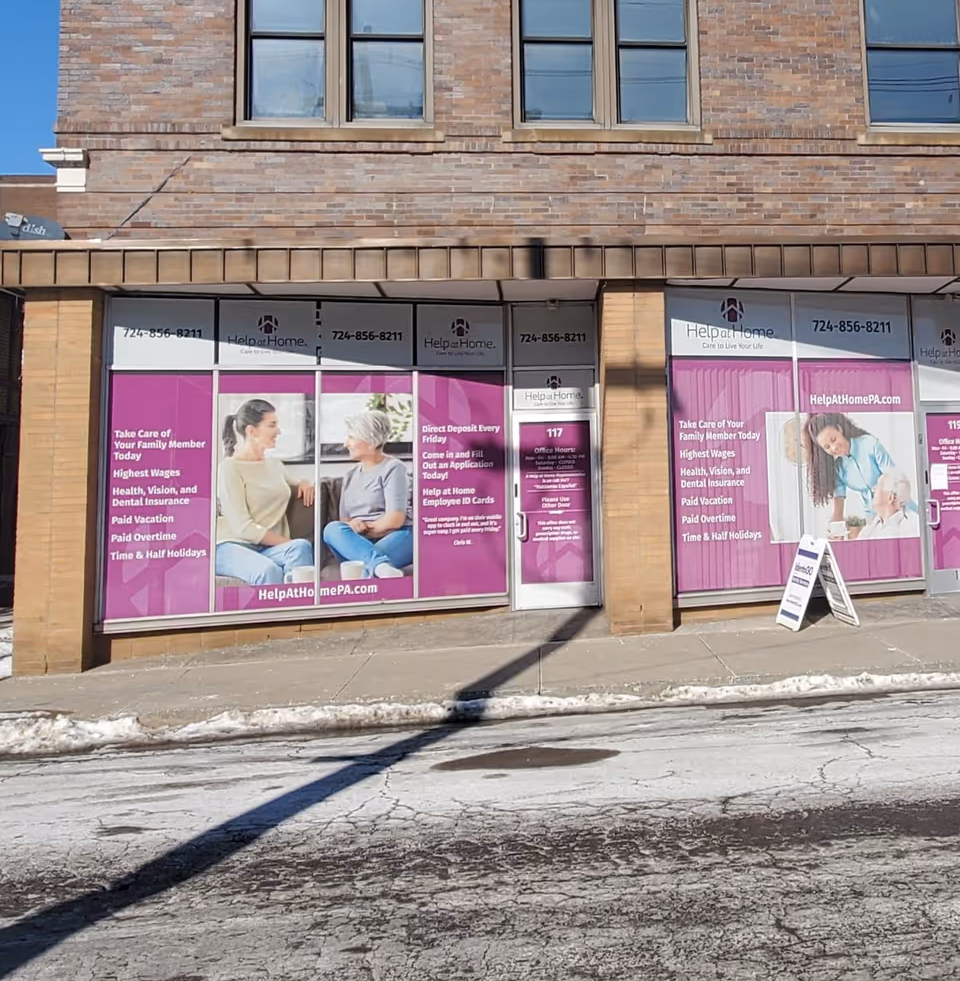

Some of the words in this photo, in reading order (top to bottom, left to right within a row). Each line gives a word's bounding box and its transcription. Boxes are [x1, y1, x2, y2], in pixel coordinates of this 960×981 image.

[22, 224, 46, 236] dish
[813, 320, 892, 333] 724-856-8211
[123, 328, 203, 338] 724-856-8211
[332, 331, 402, 341] 724-856-8211
[687, 324, 719, 341] Help
[720, 328, 732, 338] at
[227, 335, 256, 348] Help
[257, 339, 267, 347] at
[520, 333, 587, 343] 724-856-8211
[424, 338, 450, 350] Help
[450, 341, 459, 349] at
[702, 342, 716, 350] Care
[718, 342, 724, 350] to
[726, 342, 738, 350] Live
[739, 342, 752, 350] Your
[810, 393, 901, 407] HelpAtHomePA.com
[422, 425, 446, 433] Direct
[447, 424, 478, 434] Deposit
[478, 424, 500, 433] Every
[679, 420, 697, 429] Take
[699, 420, 716, 428] Care
[717, 420, 726, 428] of
[727, 420, 744, 428] Your
[114, 430, 136, 438] Take
[138, 429, 159, 438] Care
[160, 429, 171, 438] of
[546, 428, 563, 438] 117
[680, 431, 705, 442] Family
[706, 431, 737, 440] Member
[738, 431, 760, 441] Today
[422, 435, 447, 444] Friday
[114, 440, 135, 449] Your
[137, 440, 167, 450] Family
[168, 440, 206, 449] Member
[113, 451, 141, 461] Today
[422, 451, 445, 460] Come
[446, 451, 454, 459] in
[455, 451, 470, 459] and
[471, 450, 484, 458] Fill
[680, 450, 709, 460] Highest
[710, 450, 736, 460] Wages
[422, 462, 437, 470] Out
[449, 460, 494, 470] Application
[113, 468, 149, 479] Highest
[150, 468, 181, 478] Wages
[680, 467, 708, 476] Health,
[709, 466, 735, 476] Vision,
[736, 466, 751, 475] and
[422, 472, 448, 481] Today!
[681, 479, 707, 488] Dental
[708, 479, 745, 487] Insurance
[112, 486, 146, 496] Health,
[147, 485, 178, 495] Vision,
[180, 485, 198, 494] and
[422, 488, 442, 497] Help
[452, 487, 476, 495] Home
[112, 498, 143, 507] Dental
[145, 497, 190, 506] Insurance
[422, 497, 461, 507] Employee
[462, 497, 471, 505] ID
[472, 496, 495, 504] Cards
[681, 497, 699, 506] Paid
[700, 495, 733, 506] Vacation
[111, 515, 132, 524] Paid
[133, 513, 174, 523] Vacation
[682, 514, 699, 524] Paid
[700, 513, 736, 523] Overtime
[111, 533, 132, 542] Paid
[133, 531, 177, 541] Overtime
[682, 533, 702, 542] Time
[703, 532, 710, 541] &
[711, 531, 728, 540] Half
[728, 529, 762, 540] Holidays
[110, 551, 134, 560] Time
[135, 551, 144, 559] &
[146, 549, 166, 559] Half
[167, 548, 207, 558] Holidays
[258, 584, 378, 601] HelpAtHomePA.com
